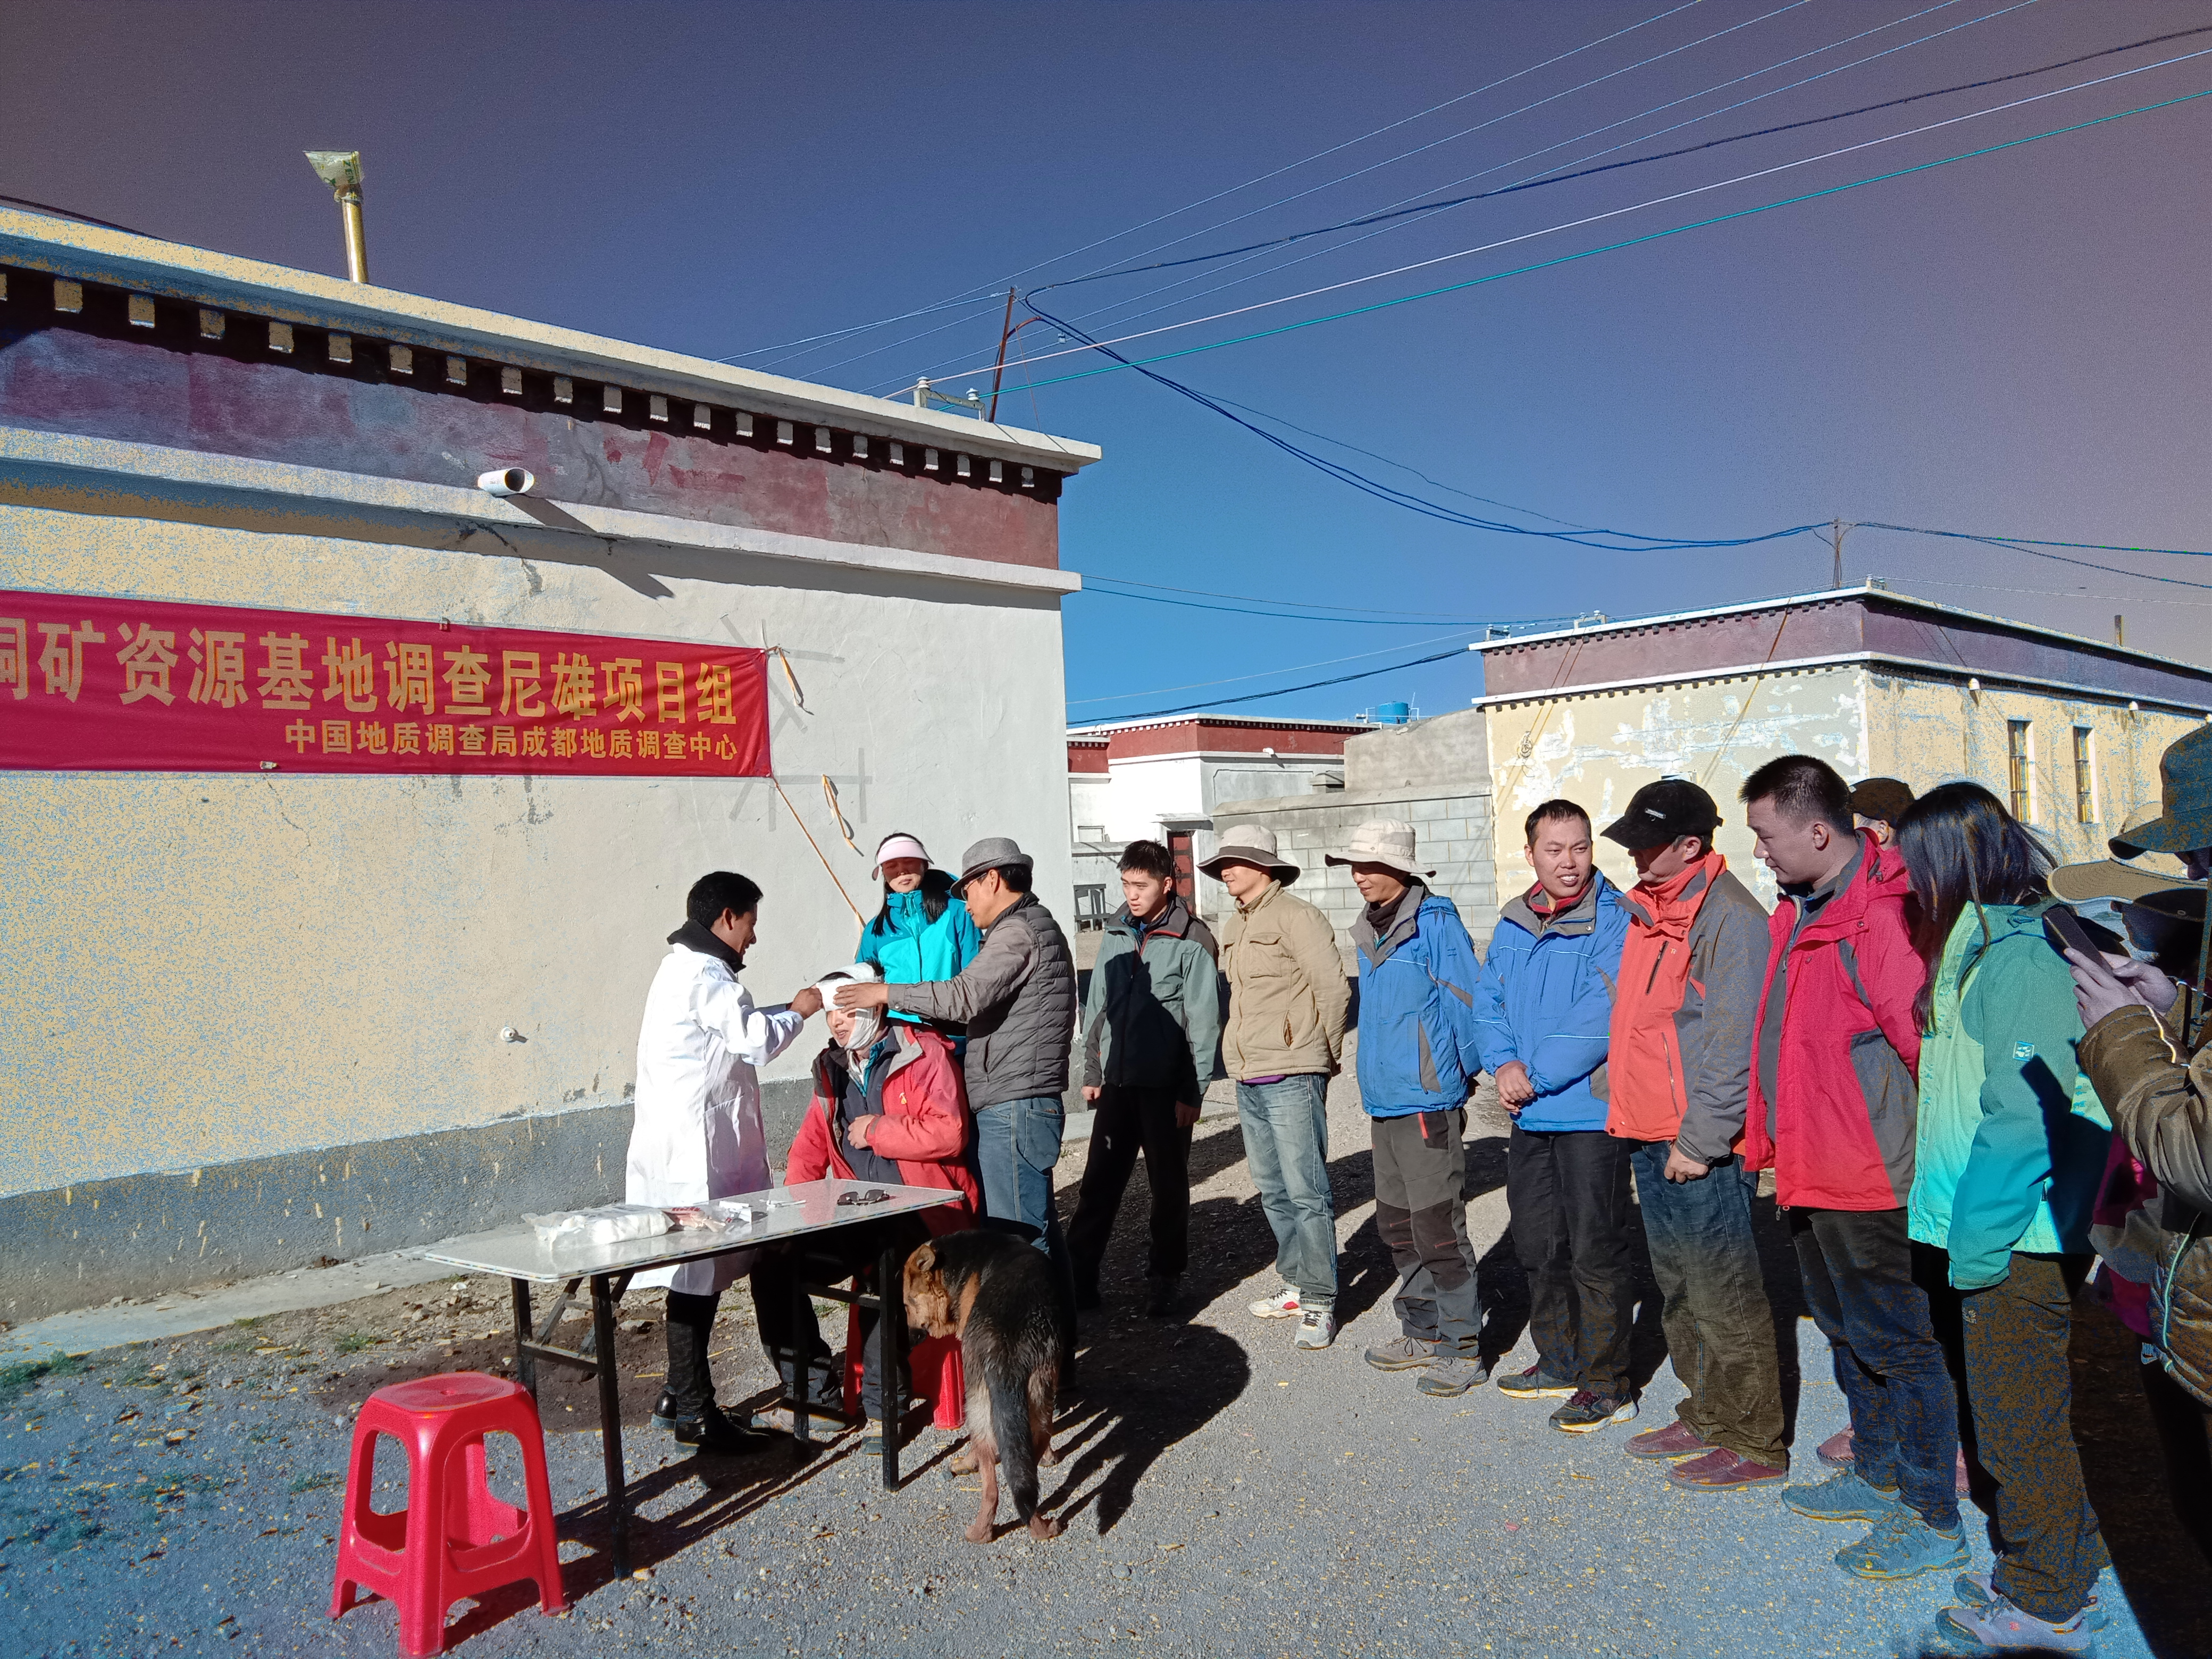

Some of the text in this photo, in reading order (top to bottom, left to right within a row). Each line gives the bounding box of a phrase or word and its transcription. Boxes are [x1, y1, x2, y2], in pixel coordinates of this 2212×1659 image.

[285, 718, 738, 761] 中国地质调查局成都地质调查中心
